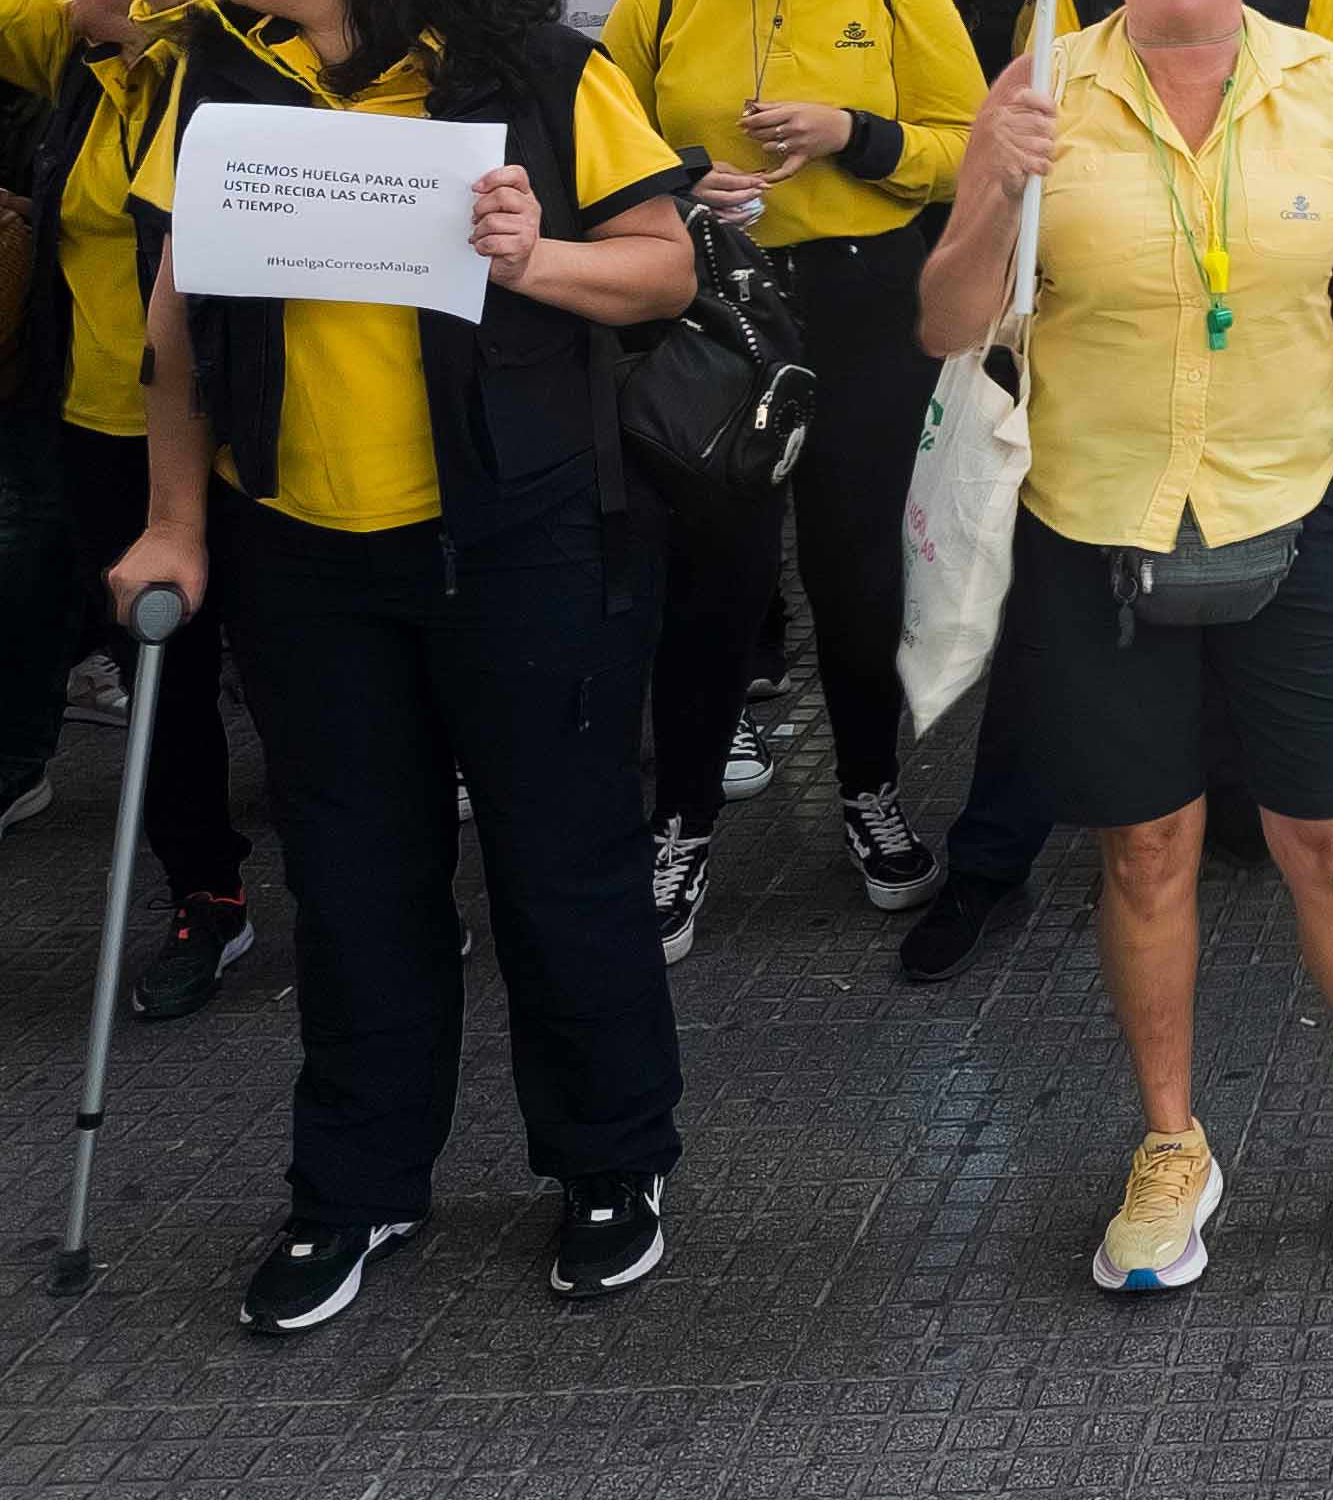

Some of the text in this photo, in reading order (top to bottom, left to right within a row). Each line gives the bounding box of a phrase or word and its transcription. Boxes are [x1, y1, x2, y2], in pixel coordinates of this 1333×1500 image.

[226, 161, 440, 191] HACEMOS HUELGA PARA QUE
[224, 180, 417, 206] USTED RECIBA LAS CARTAS
[222, 199, 299, 216] A TIEMPO.
[266, 255, 430, 276] #HuelgaCorreosMalaga
